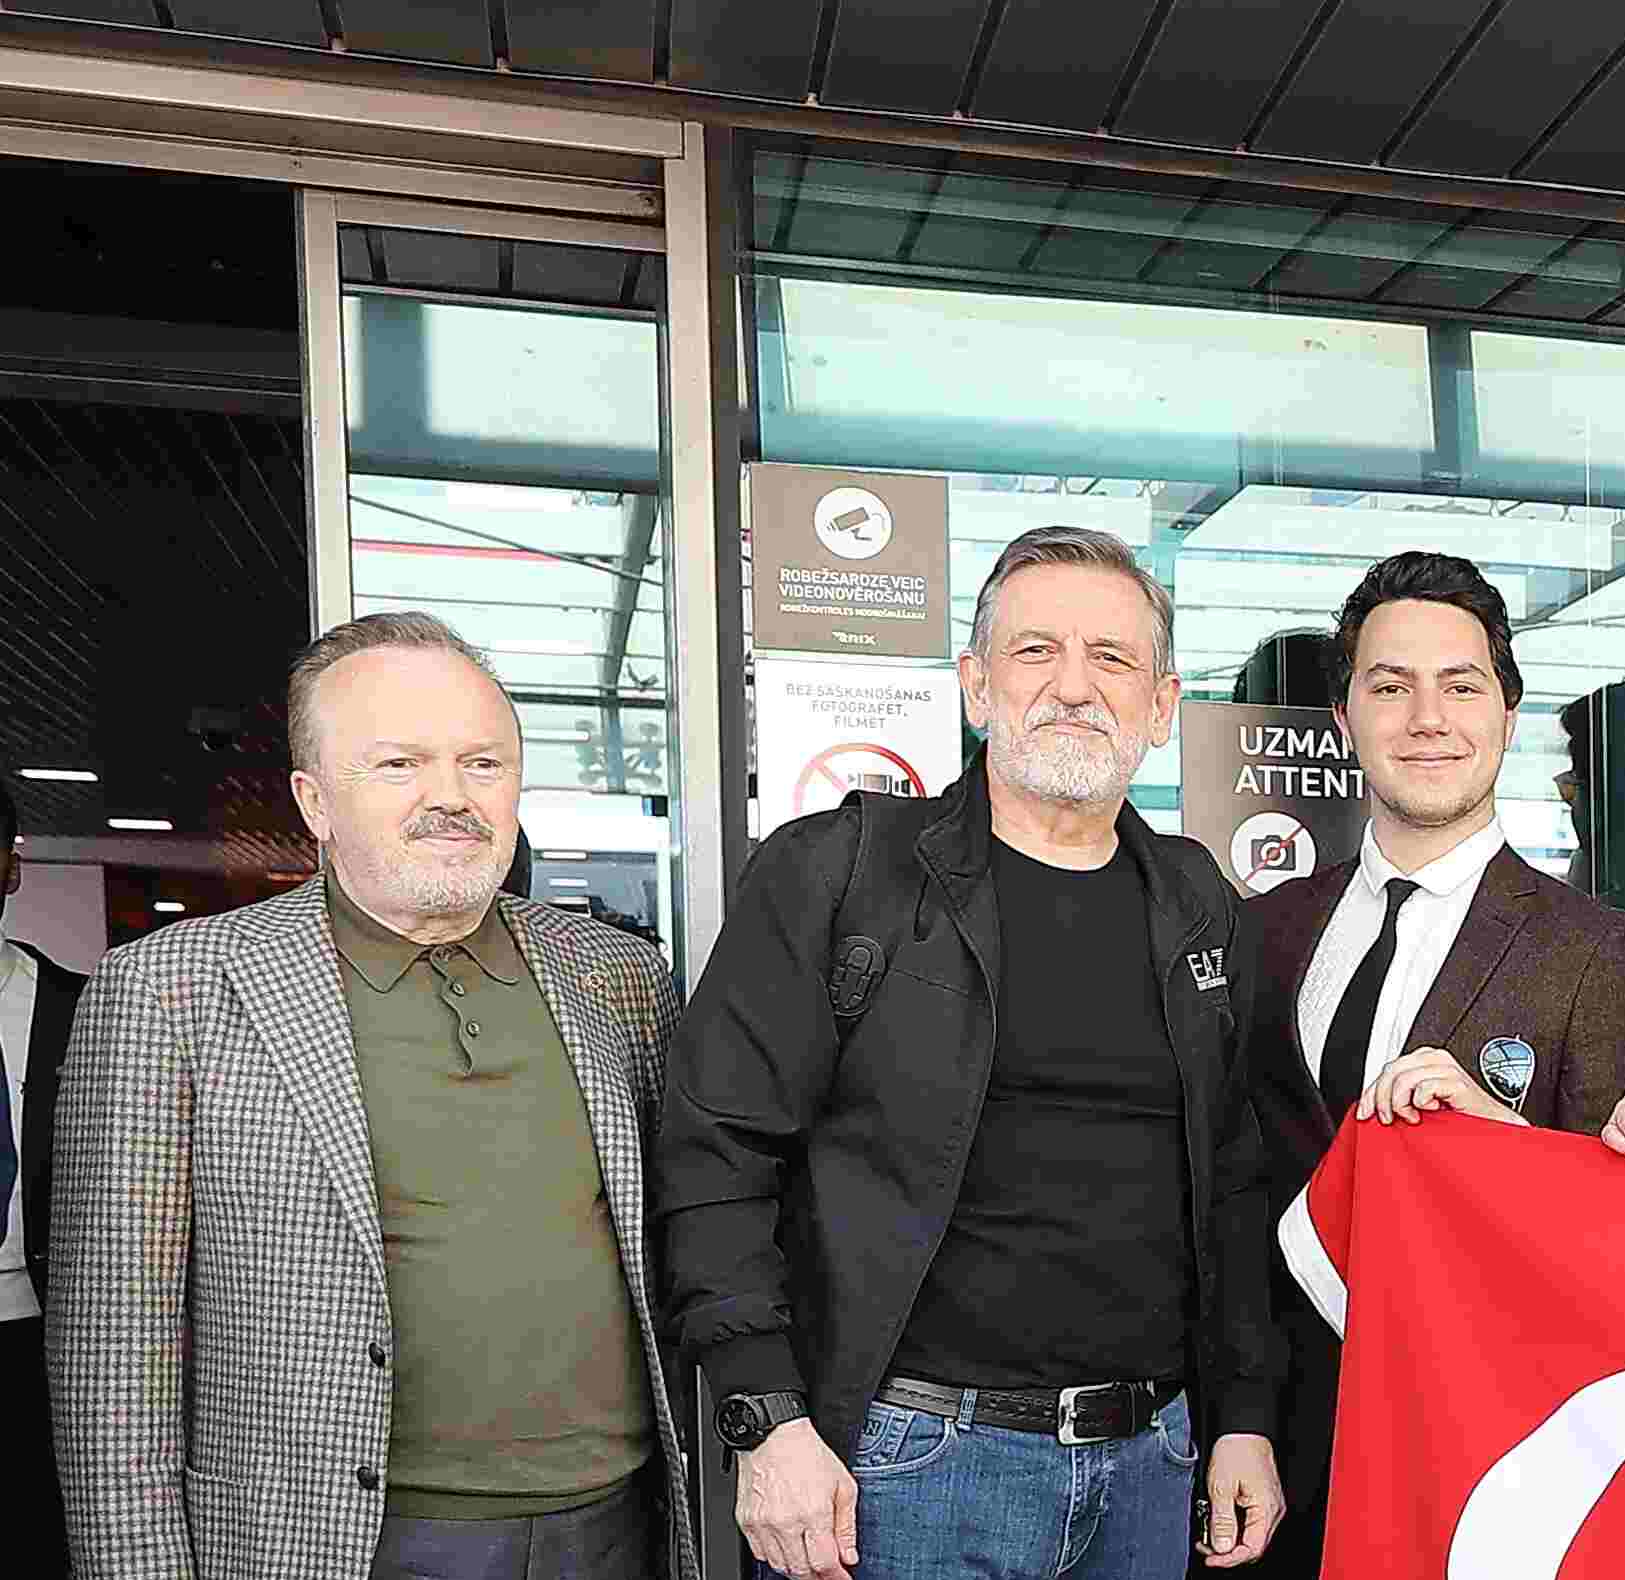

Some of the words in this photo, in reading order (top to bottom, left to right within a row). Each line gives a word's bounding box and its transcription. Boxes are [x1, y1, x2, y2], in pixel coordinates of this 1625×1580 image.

[780, 567, 888, 588] ROBEŽSARDZE
[890, 576, 925, 591] VEIC
[778, 583, 925, 606] VIDEONOVĒROŠANU
[1234, 764, 1365, 800] ATTENT
[1186, 948, 1224, 982] EA7
